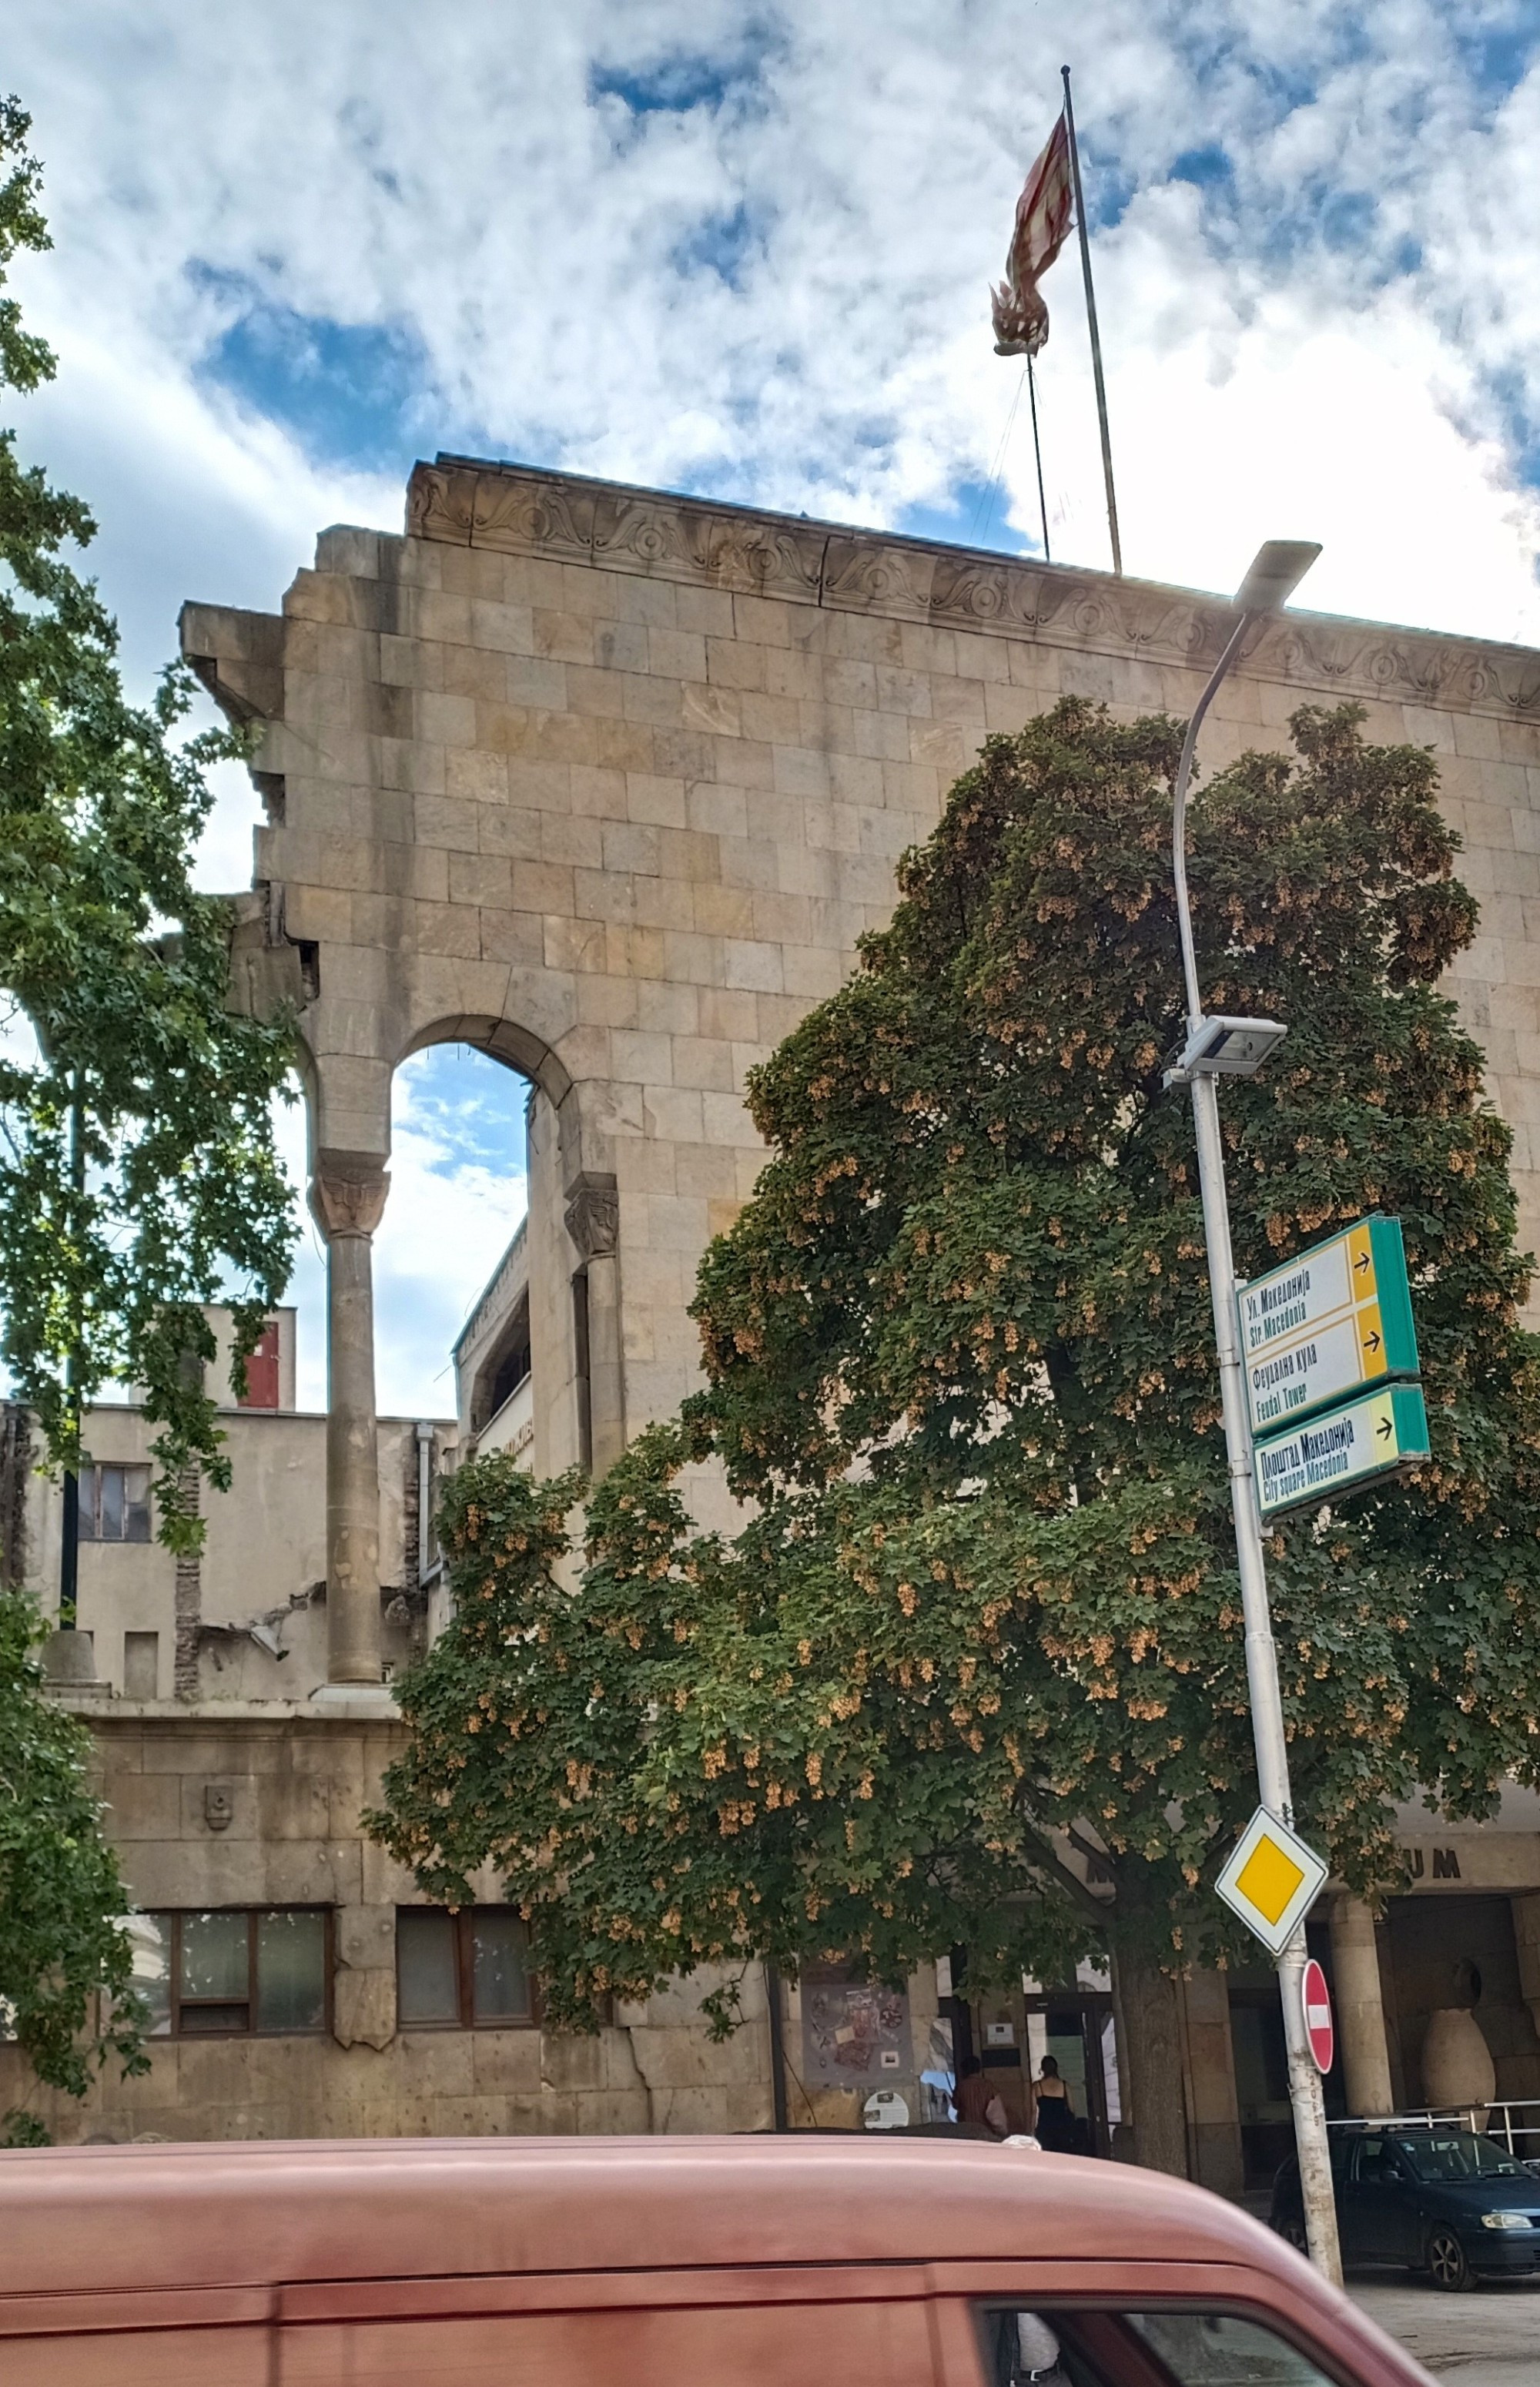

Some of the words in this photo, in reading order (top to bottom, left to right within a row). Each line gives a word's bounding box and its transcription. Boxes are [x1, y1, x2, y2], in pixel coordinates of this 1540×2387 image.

[1247, 1296, 1260, 1321] Ул.
[1260, 1269, 1311, 1314] Македонија
[1250, 1326, 1264, 1348] Str.
[1264, 1300, 1306, 1340] Macedonia
[1253, 1368, 1294, 1391] Феудална
[1296, 1344, 1317, 1373] кула
[1256, 1394, 1281, 1422] Feudal
[1282, 1383, 1307, 1409] Tower
[1260, 1443, 1301, 1480] Плоштад
[1300, 1417, 1354, 1464] Македонија
[1264, 1478, 1278, 1502] City
[1280, 1469, 1305, 1498] square
[1306, 1449, 1348, 1485] Macedonia
